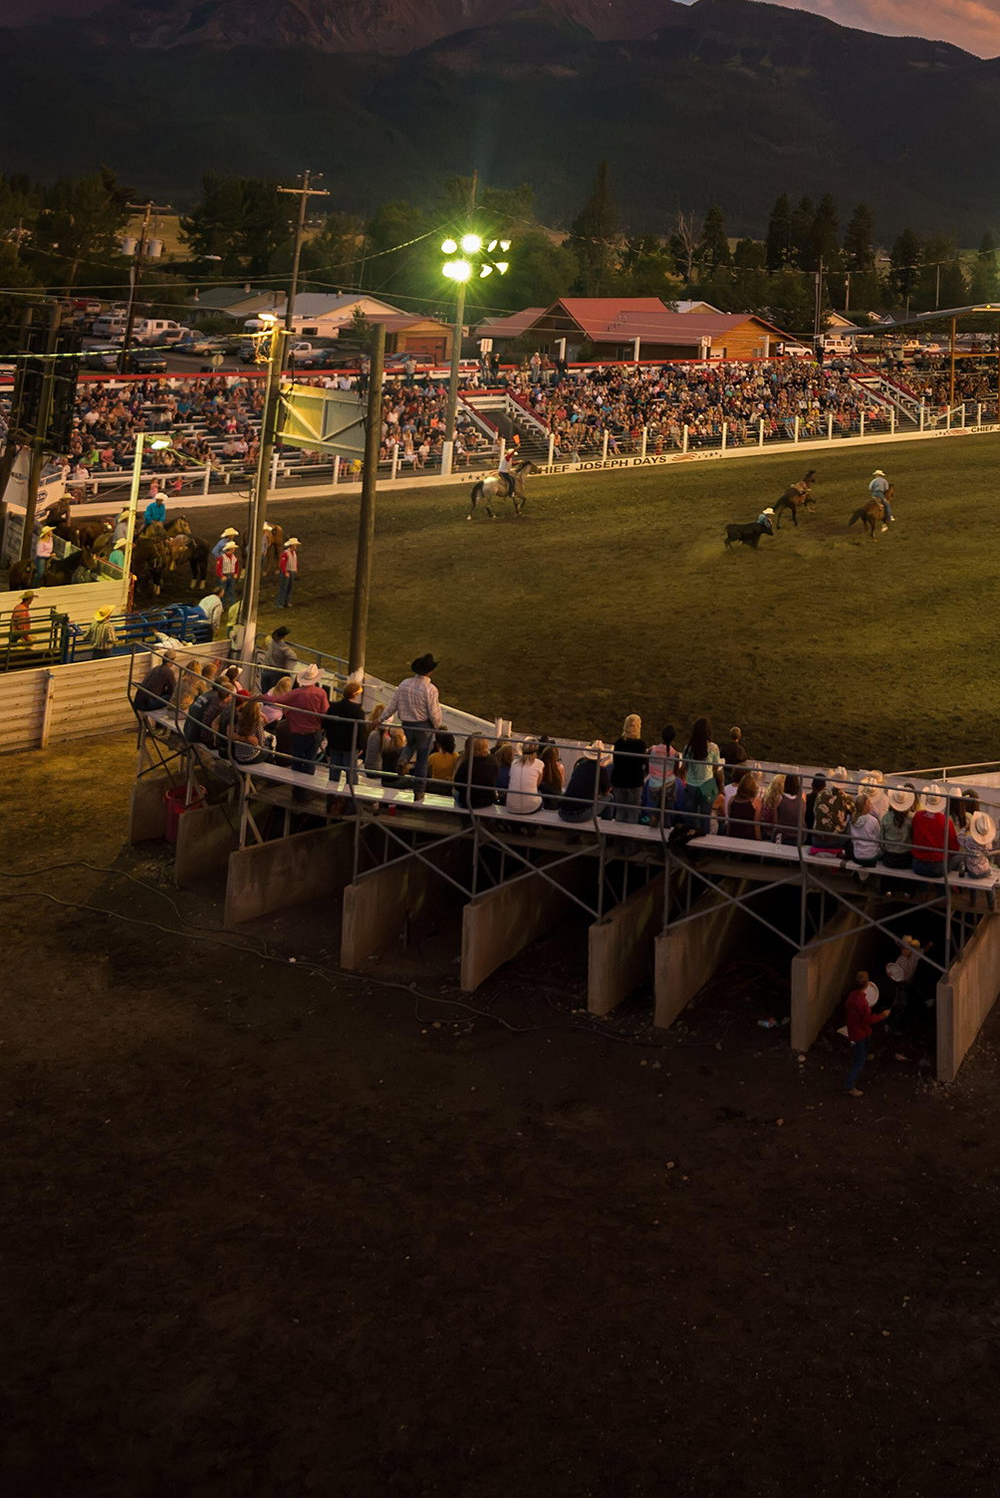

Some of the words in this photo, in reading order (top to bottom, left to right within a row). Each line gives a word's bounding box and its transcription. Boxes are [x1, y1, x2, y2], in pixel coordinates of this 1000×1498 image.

[971, 424, 993, 433] CHIEF
[575, 459, 628, 472] JOSEPH
[633, 456, 667, 466] DAYS
